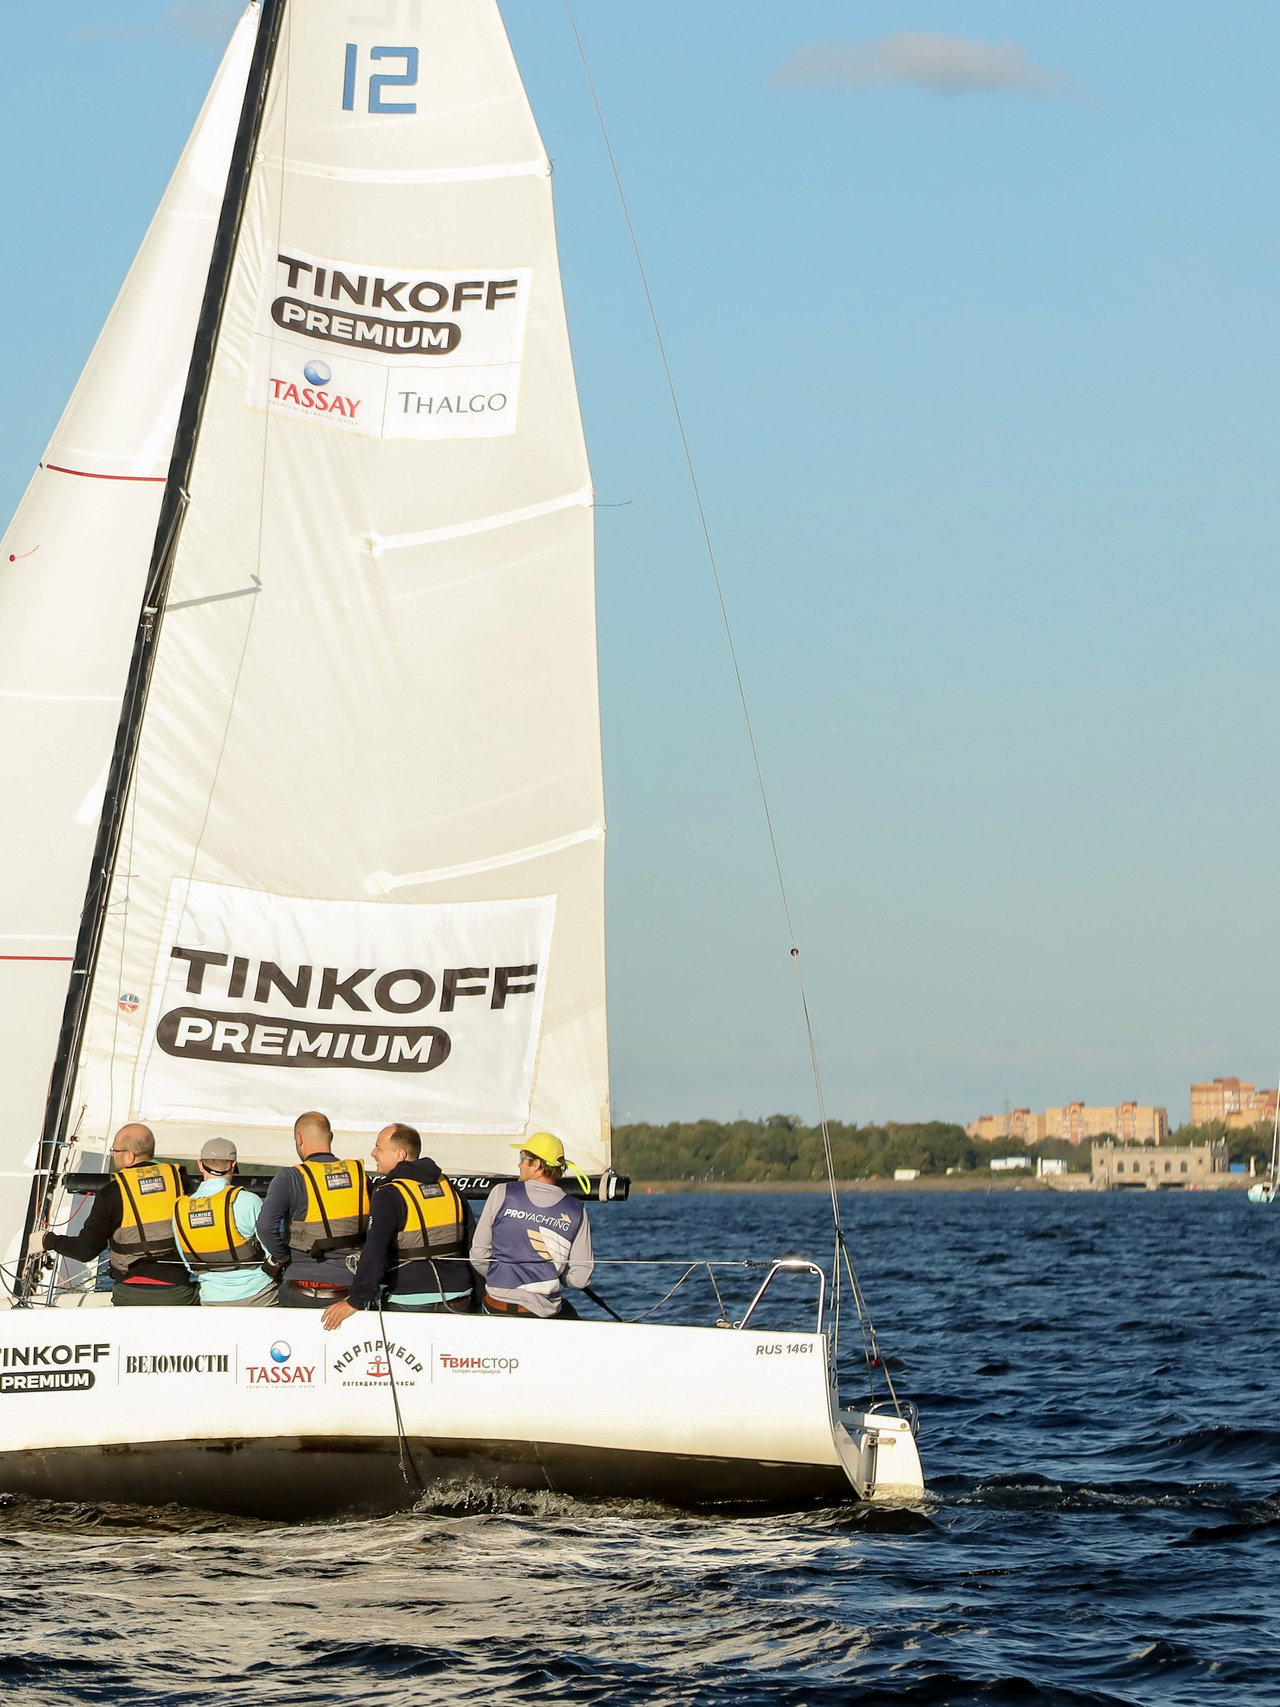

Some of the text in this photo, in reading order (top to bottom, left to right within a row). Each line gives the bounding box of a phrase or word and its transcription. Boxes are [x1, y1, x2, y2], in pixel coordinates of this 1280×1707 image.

[342, 43, 419, 114] 12
[277, 254, 518, 314] TINKOFF
[281, 301, 450, 350] PREMIUM
[269, 378, 362, 419] TASSAY
[170, 946, 538, 1014] TINKOFF
[174, 1017, 434, 1064] PREMIUM
[504, 1208, 570, 1232] PROYACHTING
[126, 1354, 229, 1375] ВЕДОМОСТИ
[333, 1340, 424, 1373] МОРПРИБОР
[756, 1343, 814, 1355] RUS 1461
[1, 1372, 90, 1390] PREMIUM
[245, 1366, 316, 1383] TASSAY
